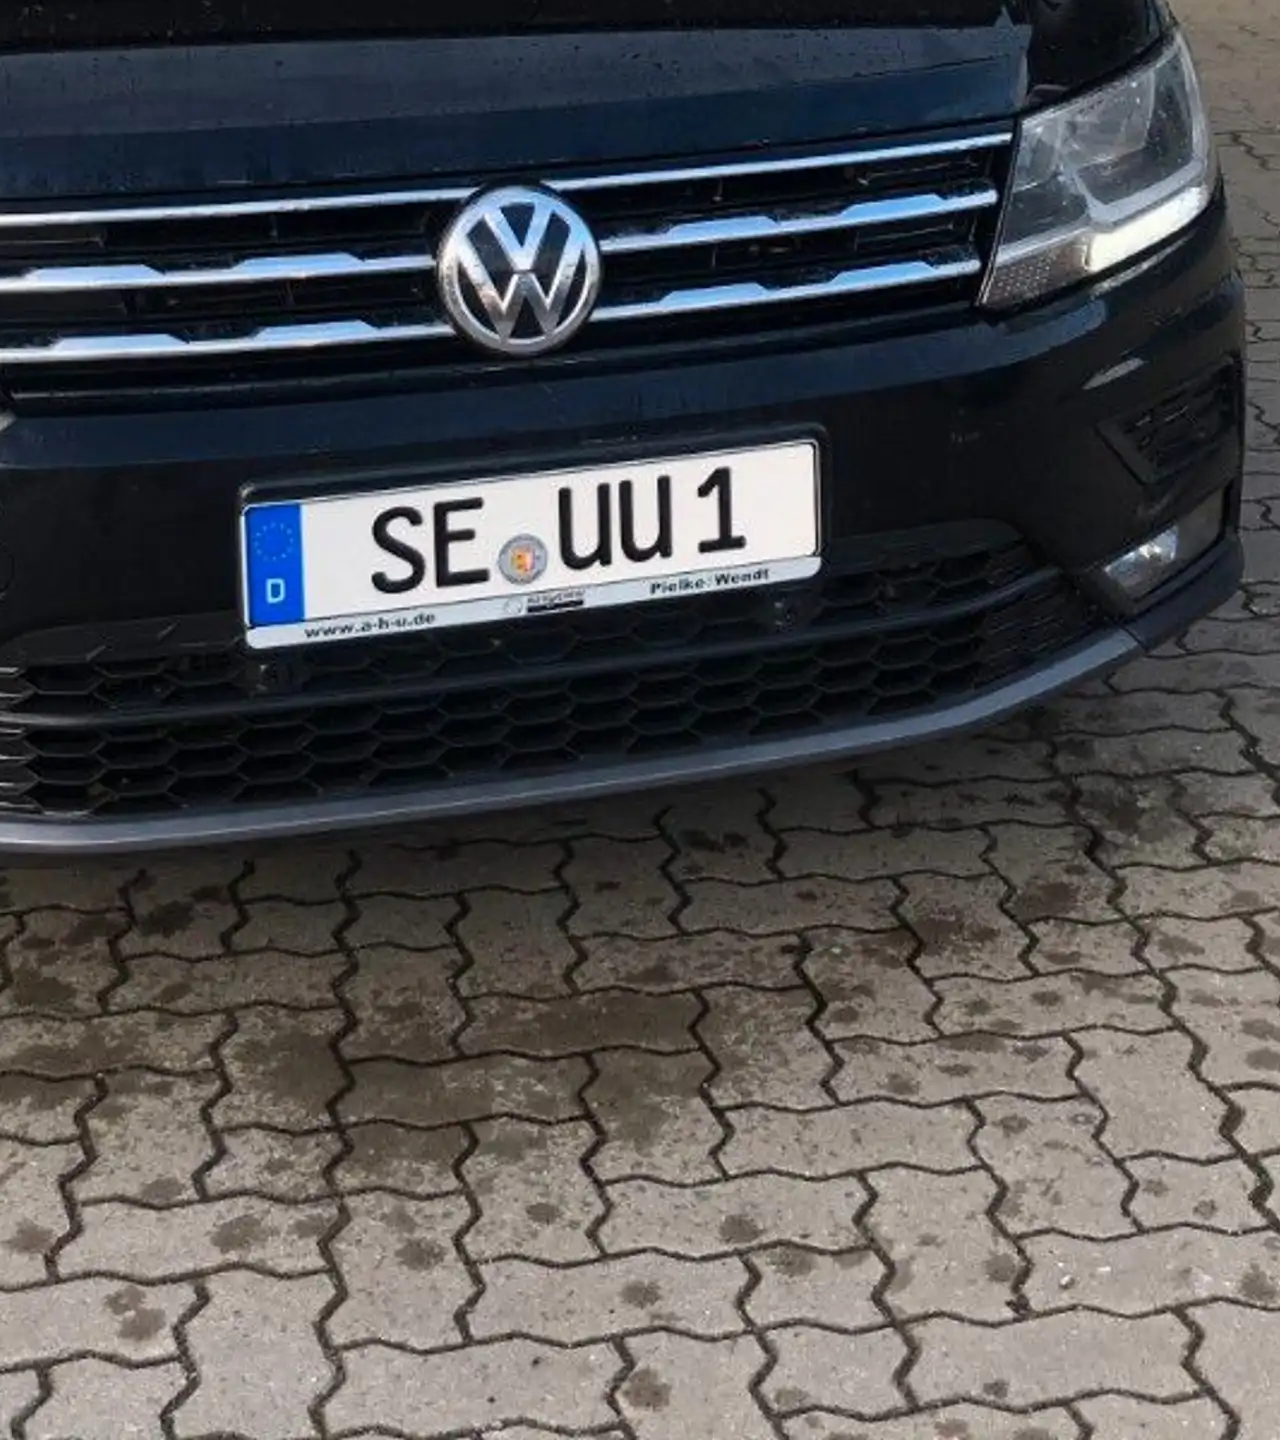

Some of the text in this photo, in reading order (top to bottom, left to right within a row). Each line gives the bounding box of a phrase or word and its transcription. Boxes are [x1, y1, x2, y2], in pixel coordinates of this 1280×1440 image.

[371, 465, 747, 594] SE UU 1
[265, 578, 286, 604] D
[303, 611, 437, 639] www.a-h-u.de
